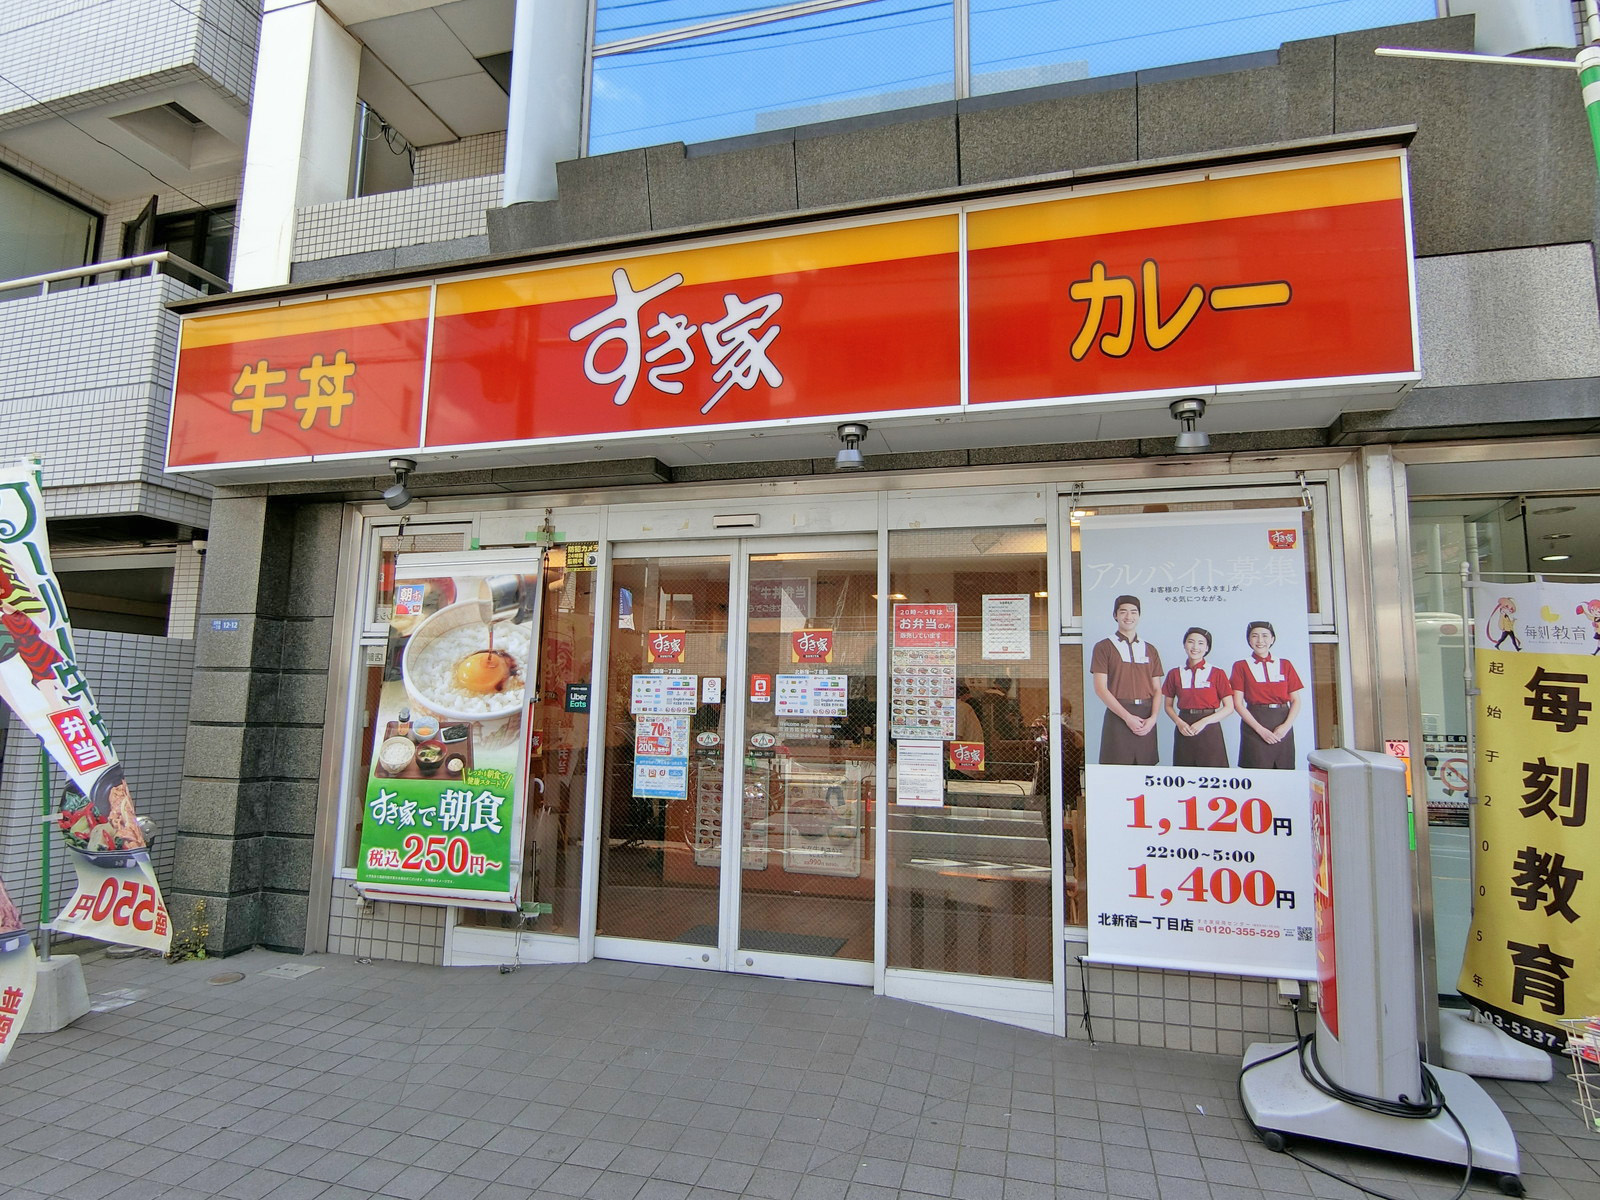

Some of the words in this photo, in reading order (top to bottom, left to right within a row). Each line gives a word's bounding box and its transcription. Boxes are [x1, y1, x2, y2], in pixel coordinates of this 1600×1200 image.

[1069, 257, 1292, 362] カレー
[569, 267, 783, 415] すき家
[231, 350, 356, 433] 牛丼
[1088, 556, 1298, 592] アルバイト募集
[1150, 584, 1243, 594] お客様の「ごちそうさま」が、
[1165, 595, 1228, 603] やる気につながる。
[900, 618, 952, 630] お弁当のみ
[653, 633, 681, 655] すき家
[797, 632, 828, 655] すき家
[570, 692, 587, 701] Uber
[570, 700, 587, 708] Eats
[60, 715, 102, 766] 弁当
[954, 744, 981, 763] すき家
[369, 789, 506, 834] すき家で朝食
[1126, 794, 1292, 837] 1,120円
[1128, 864, 1296, 910] 1,400円
[1098, 913, 1194, 932] 北新宿一丁目店
[1205, 925, 1280, 938] 0120-355-529
[1484, 1011, 1570, 1048] 03-5337-
